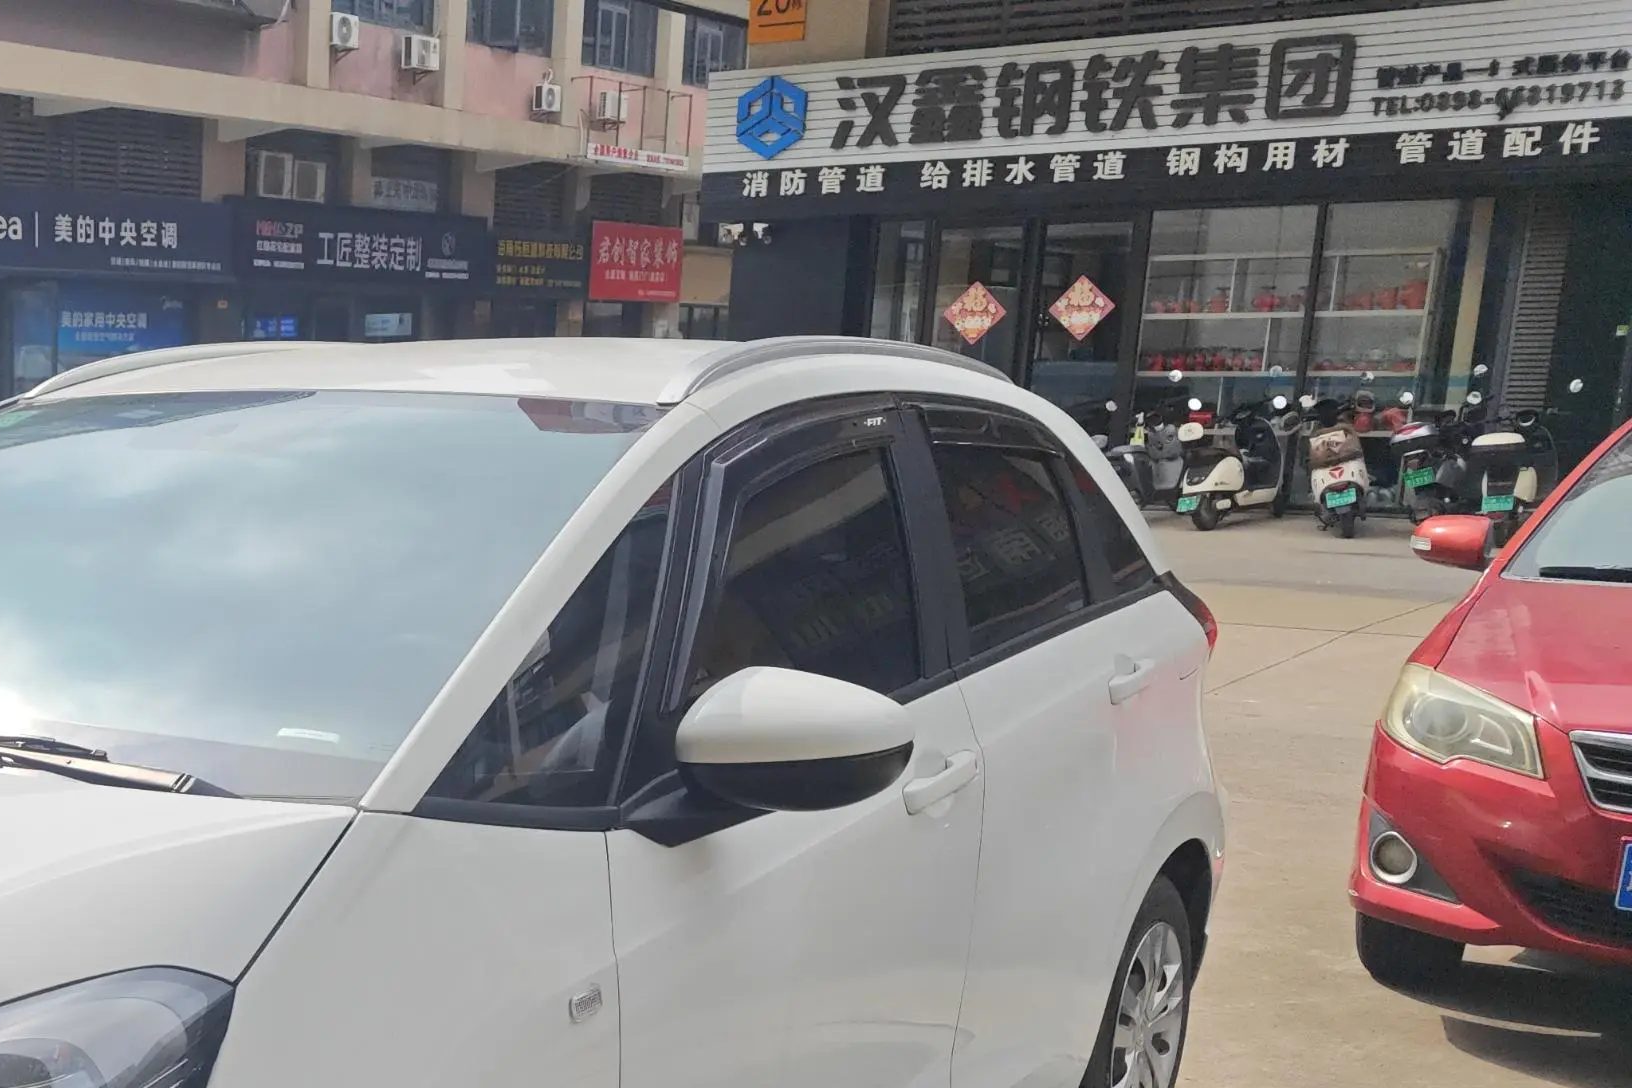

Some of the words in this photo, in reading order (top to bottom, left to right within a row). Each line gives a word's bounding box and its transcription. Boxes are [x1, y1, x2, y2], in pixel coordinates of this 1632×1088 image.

[829, 33, 1356, 150] 汉鑫钢铁集团
[741, 165, 887, 198] 消防管道
[919, 151, 1128, 190] 给排水管道
[1166, 137, 1350, 177] 钢构用材
[1395, 121, 1601, 165] 管道配件
[54, 213, 177, 248] 美的中央空调
[316, 231, 422, 271] 工匠整装定制
